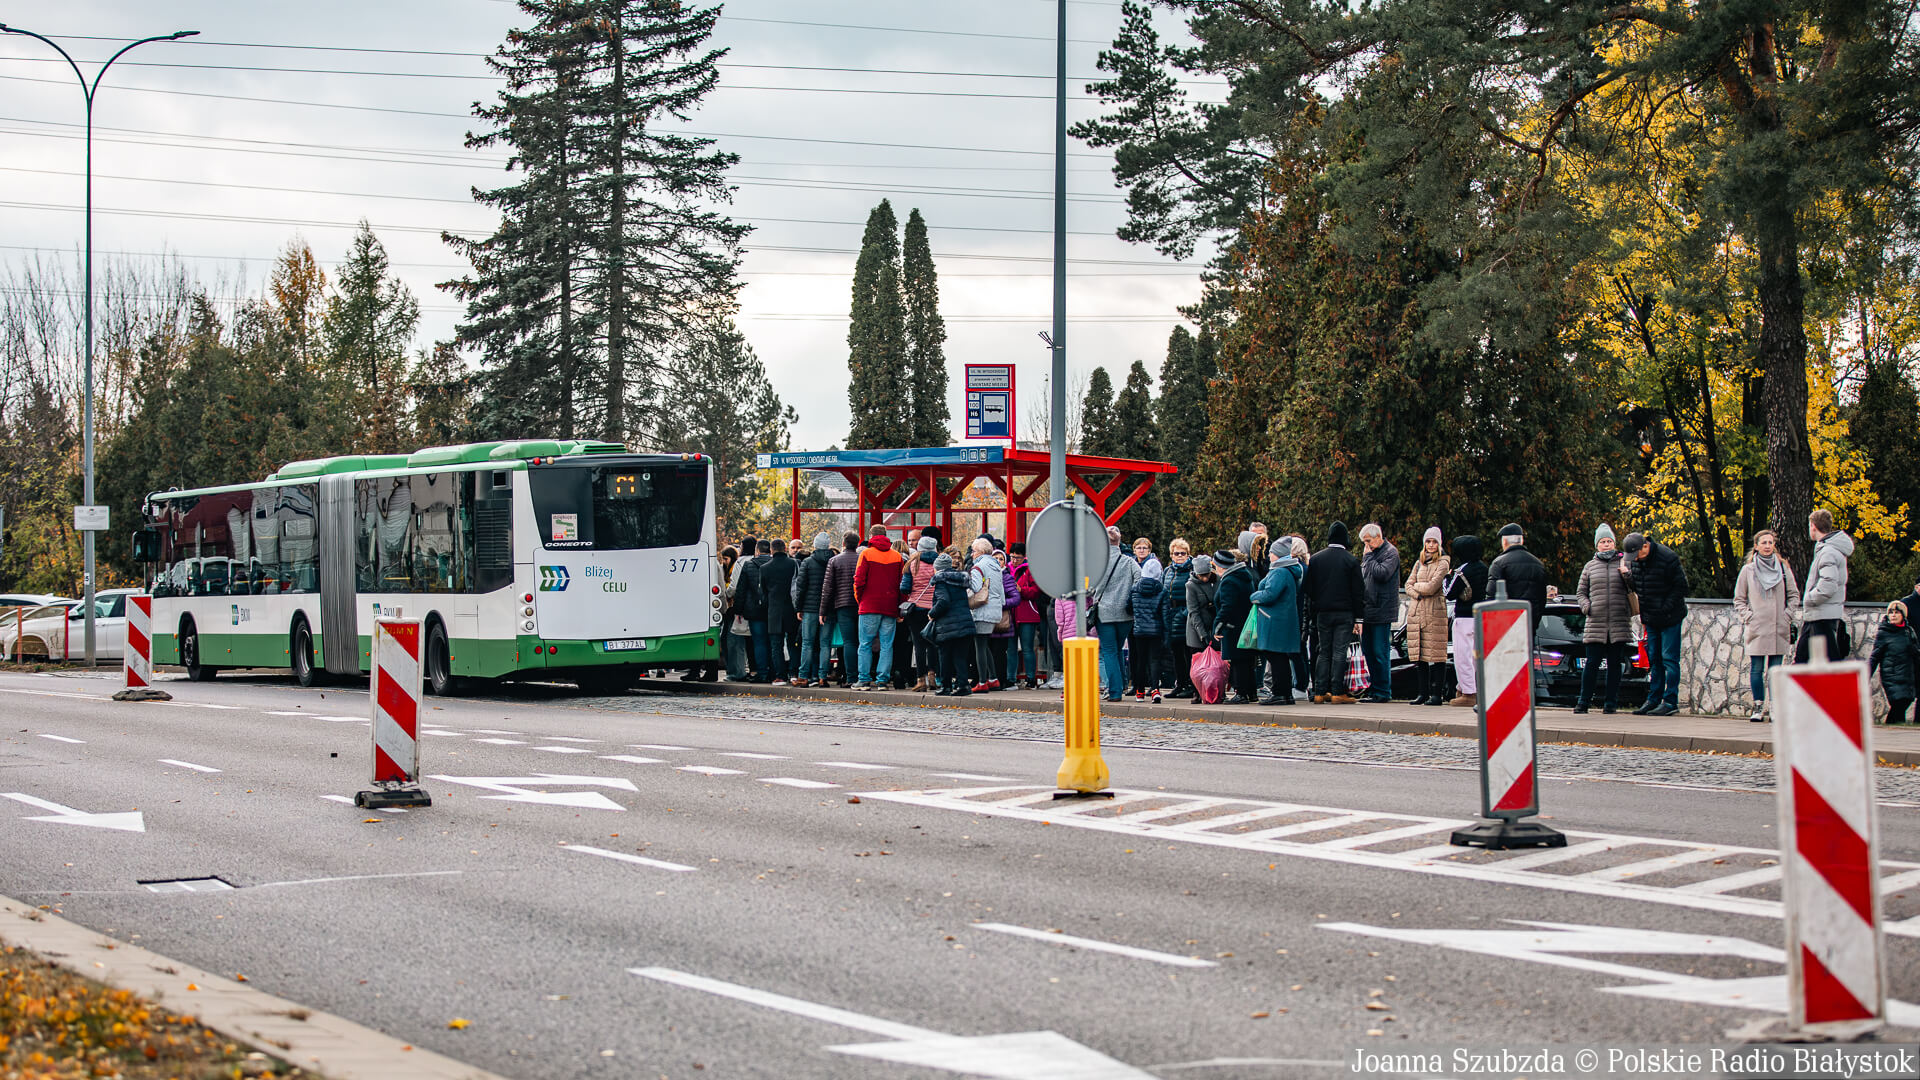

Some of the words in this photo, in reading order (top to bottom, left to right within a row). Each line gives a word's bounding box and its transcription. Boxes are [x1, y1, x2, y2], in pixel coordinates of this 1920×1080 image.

[669, 558, 699, 572] 377
[585, 566, 613, 580] Bliżej
[602, 582, 627, 593] CELU
